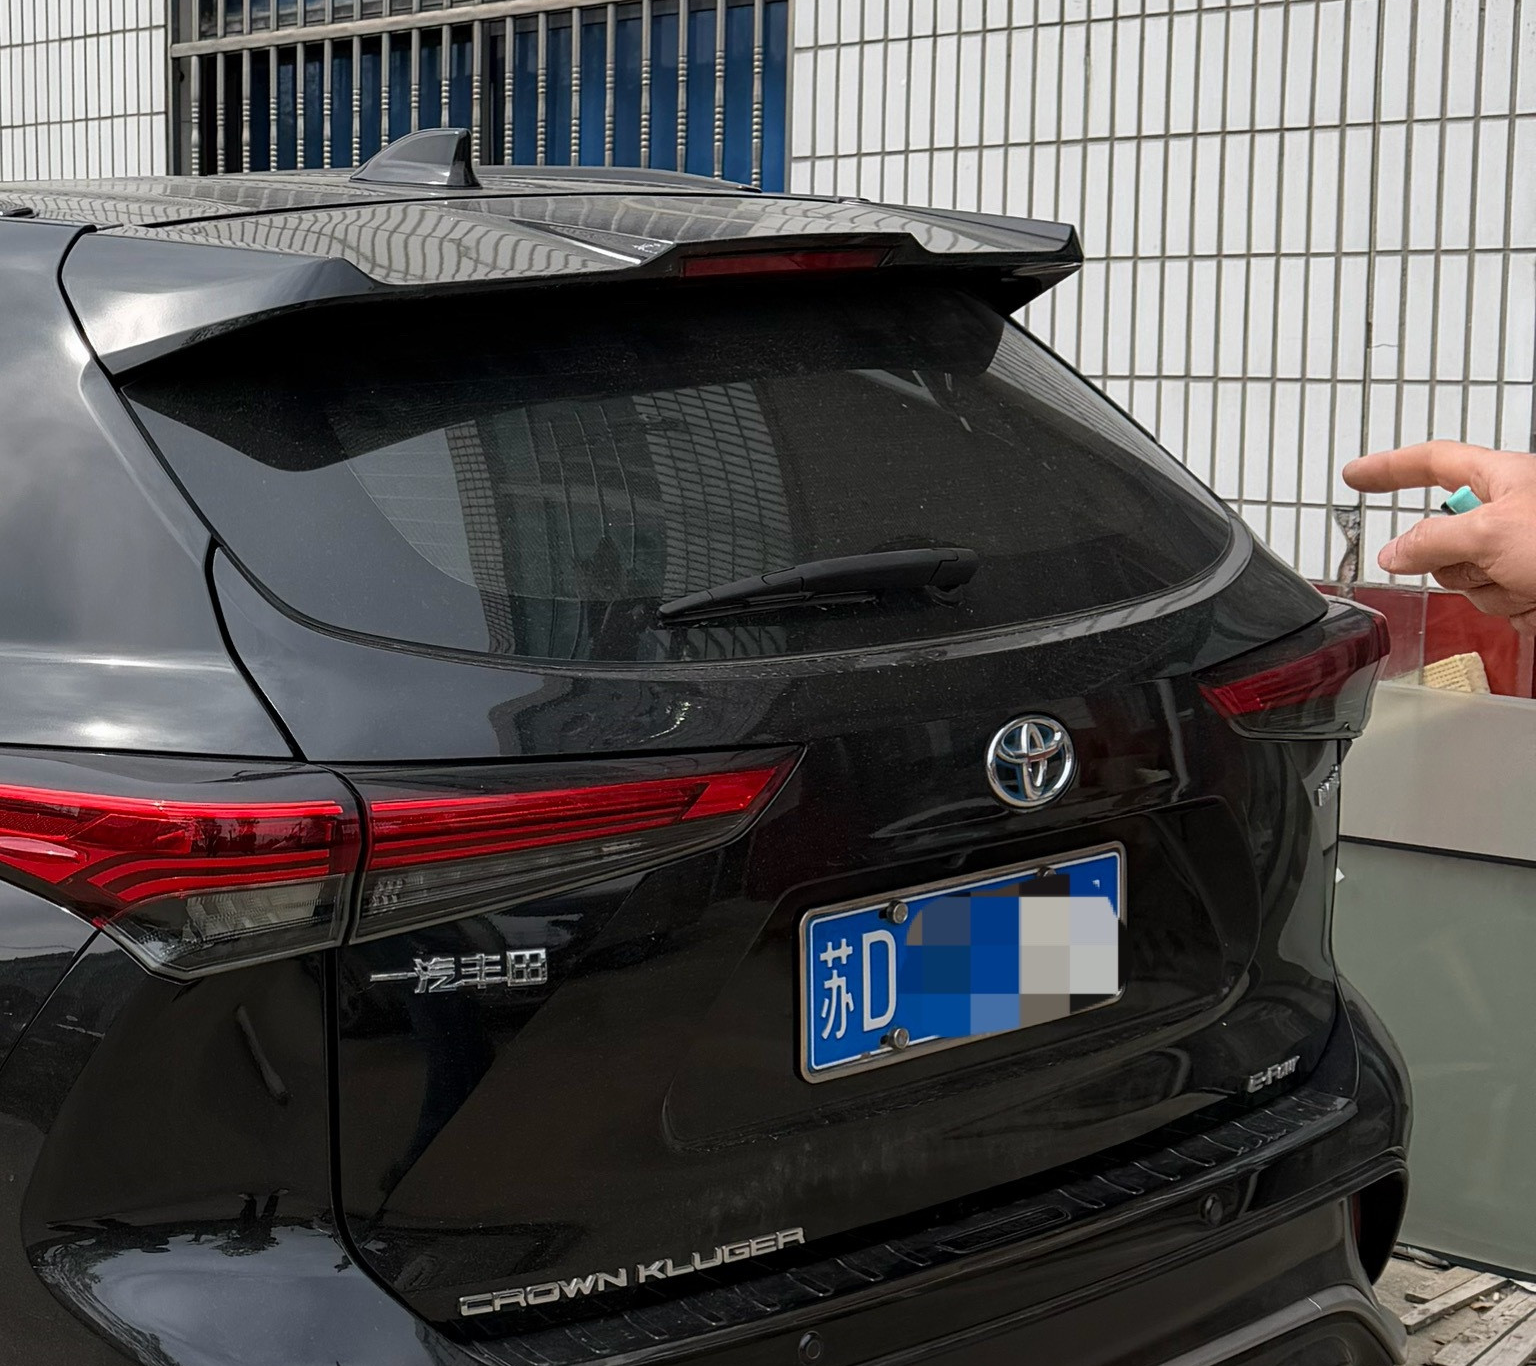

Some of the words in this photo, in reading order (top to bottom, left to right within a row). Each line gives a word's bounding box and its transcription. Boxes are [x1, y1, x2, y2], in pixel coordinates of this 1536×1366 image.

[370, 948, 548, 994] 一汽丰田
[458, 1267, 628, 1317] CROWN
[636, 1226, 807, 1284] KLUGER
